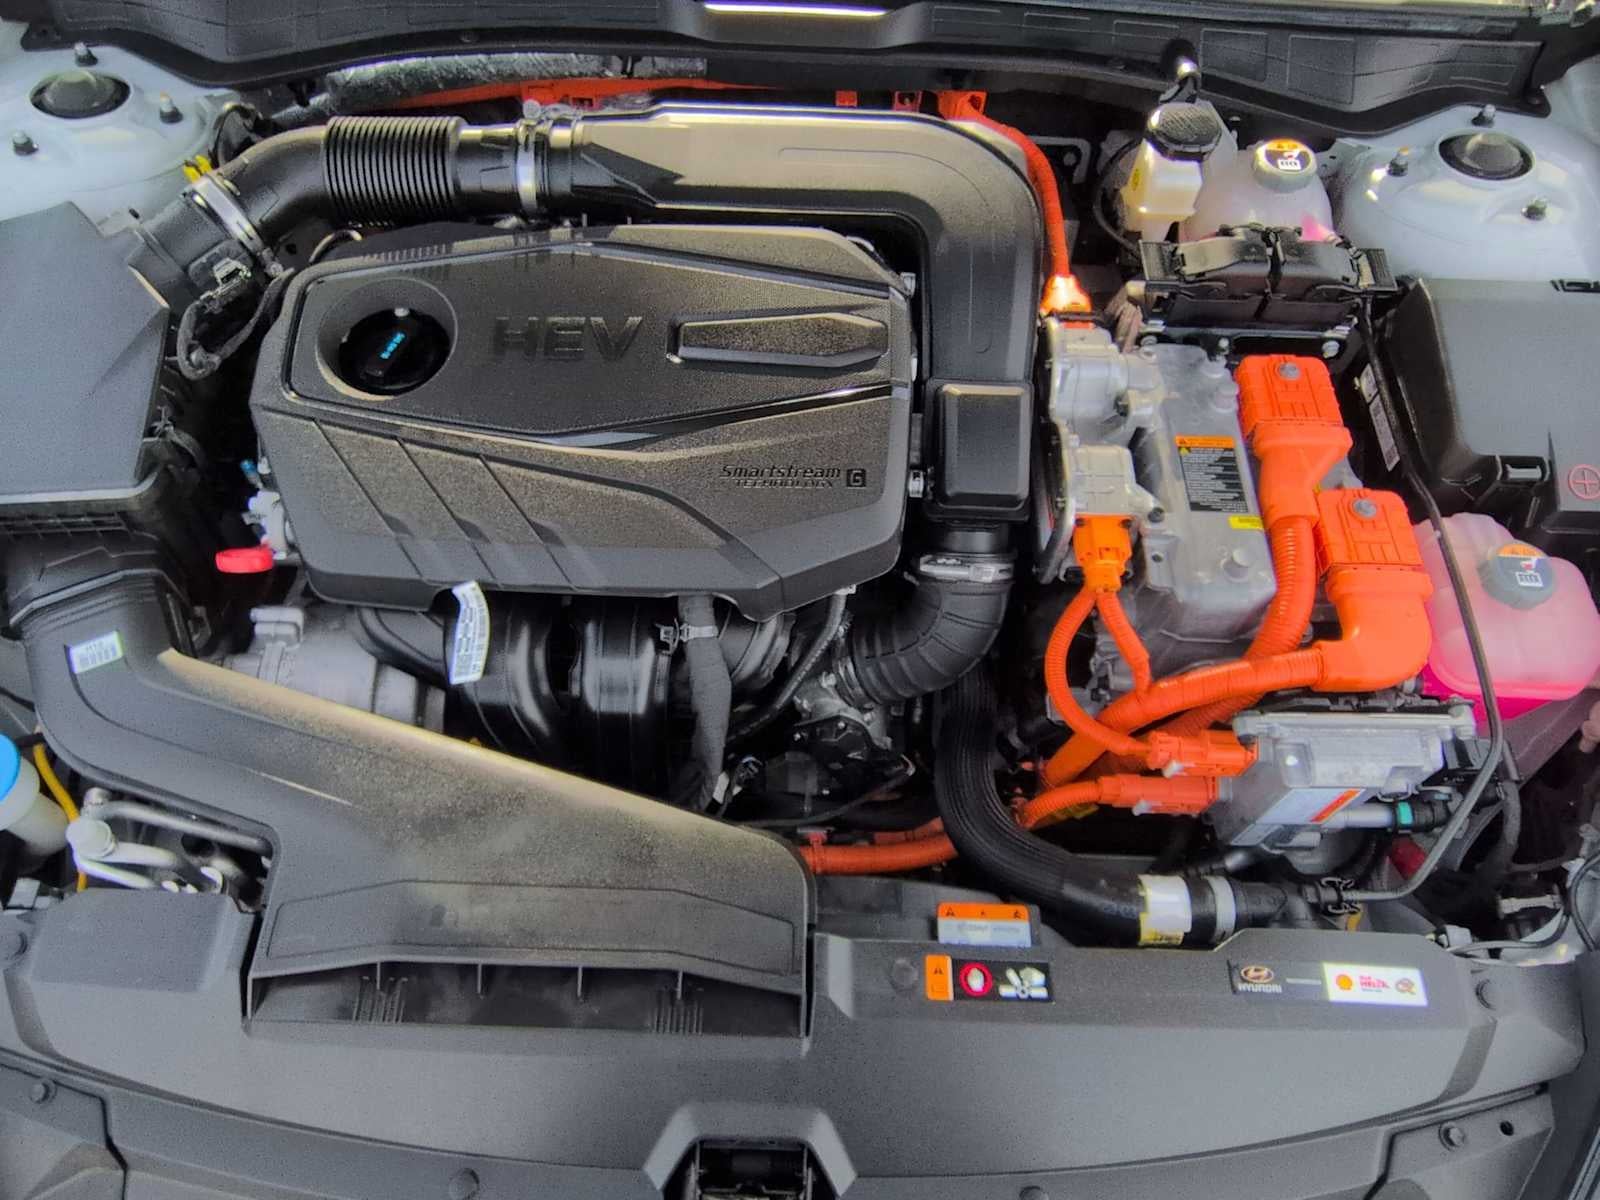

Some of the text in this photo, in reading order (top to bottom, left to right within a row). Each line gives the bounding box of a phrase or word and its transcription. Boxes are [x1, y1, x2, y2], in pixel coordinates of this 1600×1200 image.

[494, 315, 643, 361] HEV
[720, 464, 866, 488] Smartstream G
[1237, 983, 1283, 994] HYUNDAI
